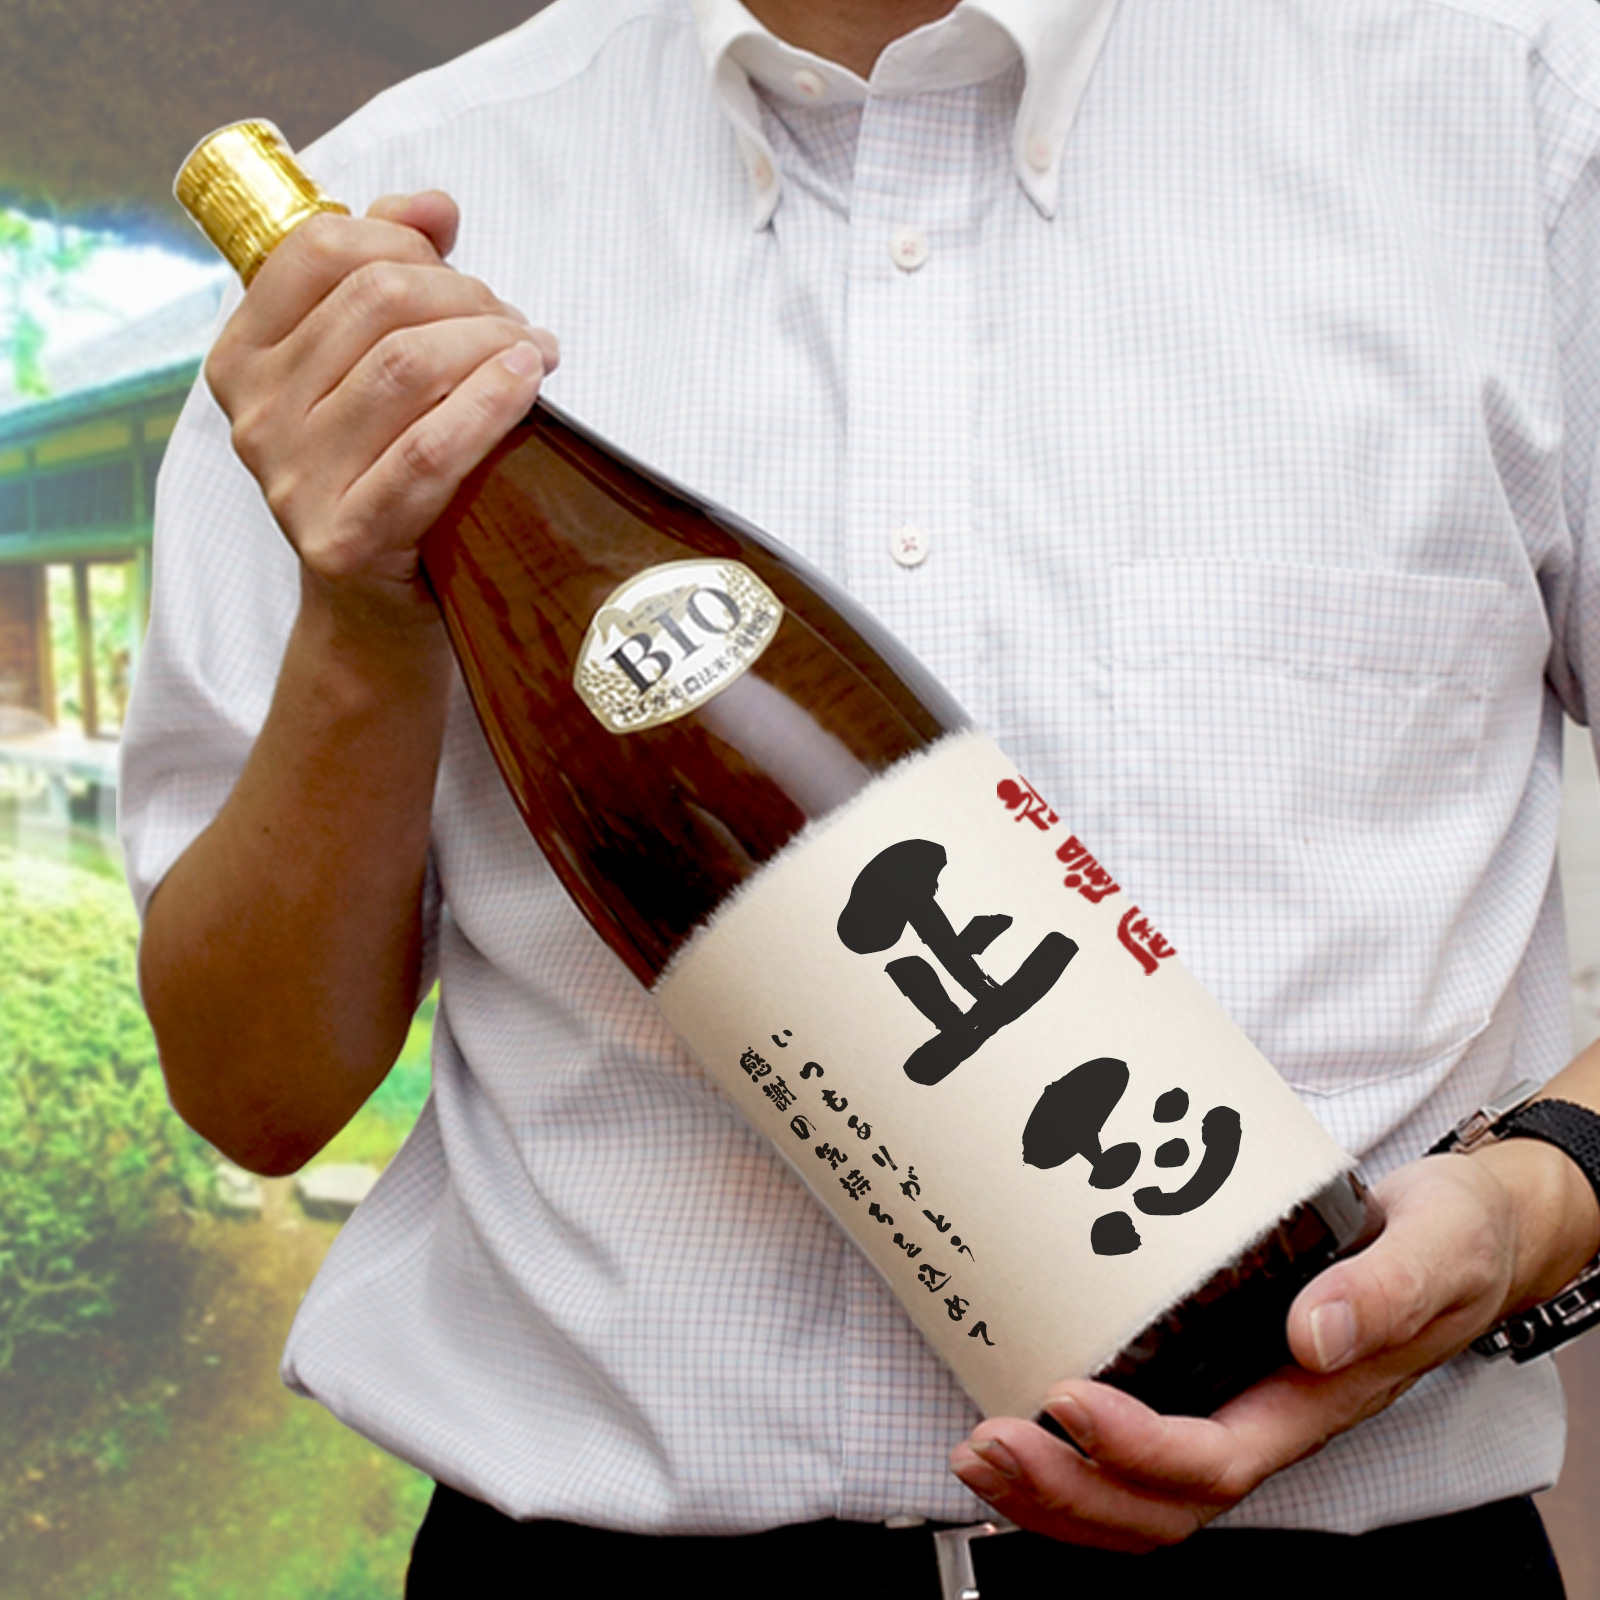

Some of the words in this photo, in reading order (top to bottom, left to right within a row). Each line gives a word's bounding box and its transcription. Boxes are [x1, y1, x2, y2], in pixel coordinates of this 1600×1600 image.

[605, 588, 742, 697] BIO
[739, 1046, 995, 1347] 感謝の気持ちを込めて
[771, 1029, 976, 1262] いつもありがとう
